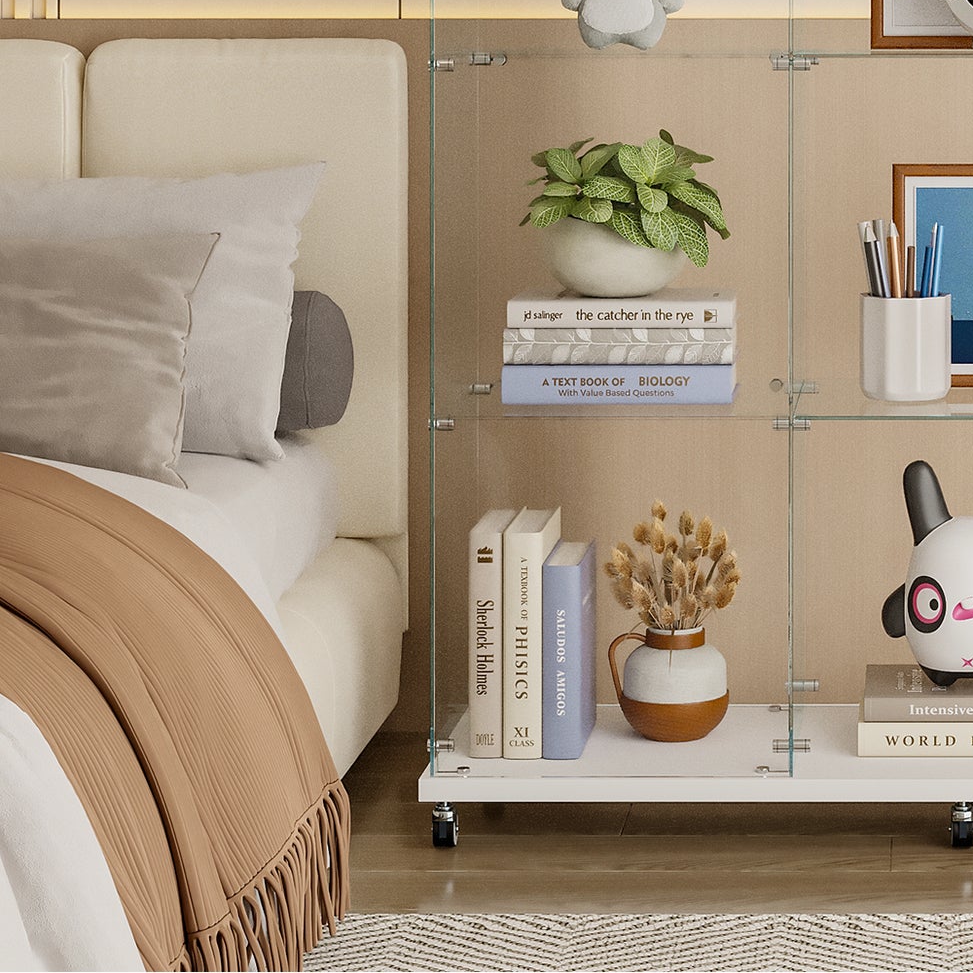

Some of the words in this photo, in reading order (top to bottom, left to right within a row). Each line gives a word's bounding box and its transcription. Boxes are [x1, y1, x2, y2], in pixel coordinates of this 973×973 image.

[523, 310, 531, 322] jd
[534, 311, 563, 321] salinger
[576, 309, 594, 320] the
[597, 309, 639, 320] catcher
[640, 309, 651, 320] in
[654, 309, 672, 320] the
[676, 311, 694, 323] rye
[552, 378, 578, 386] TEXT
[580, 378, 609, 386] BOOK
[612, 378, 625, 386] OF
[639, 376, 690, 386] BIOLOGY
[558, 389, 578, 397] With
[580, 389, 603, 397] Value
[606, 389, 630, 397] Based
[632, 389, 674, 397] Questions
[520, 565, 528, 606] TEXBOOK
[520, 609, 528, 620] OF
[477, 600, 494, 649] Sherlock
[556, 609, 565, 663] SALUDOS
[515, 627, 528, 700] PHISICS
[477, 654, 494, 696] Holmes
[556, 671, 565, 716] AMIGOS
[909, 704, 973, 715] Intensive
[514, 727, 529, 737] XI
[476, 734, 494, 745] DOYLE
[509, 739, 535, 747] CLASS
[885, 735, 956, 747] WORLD
